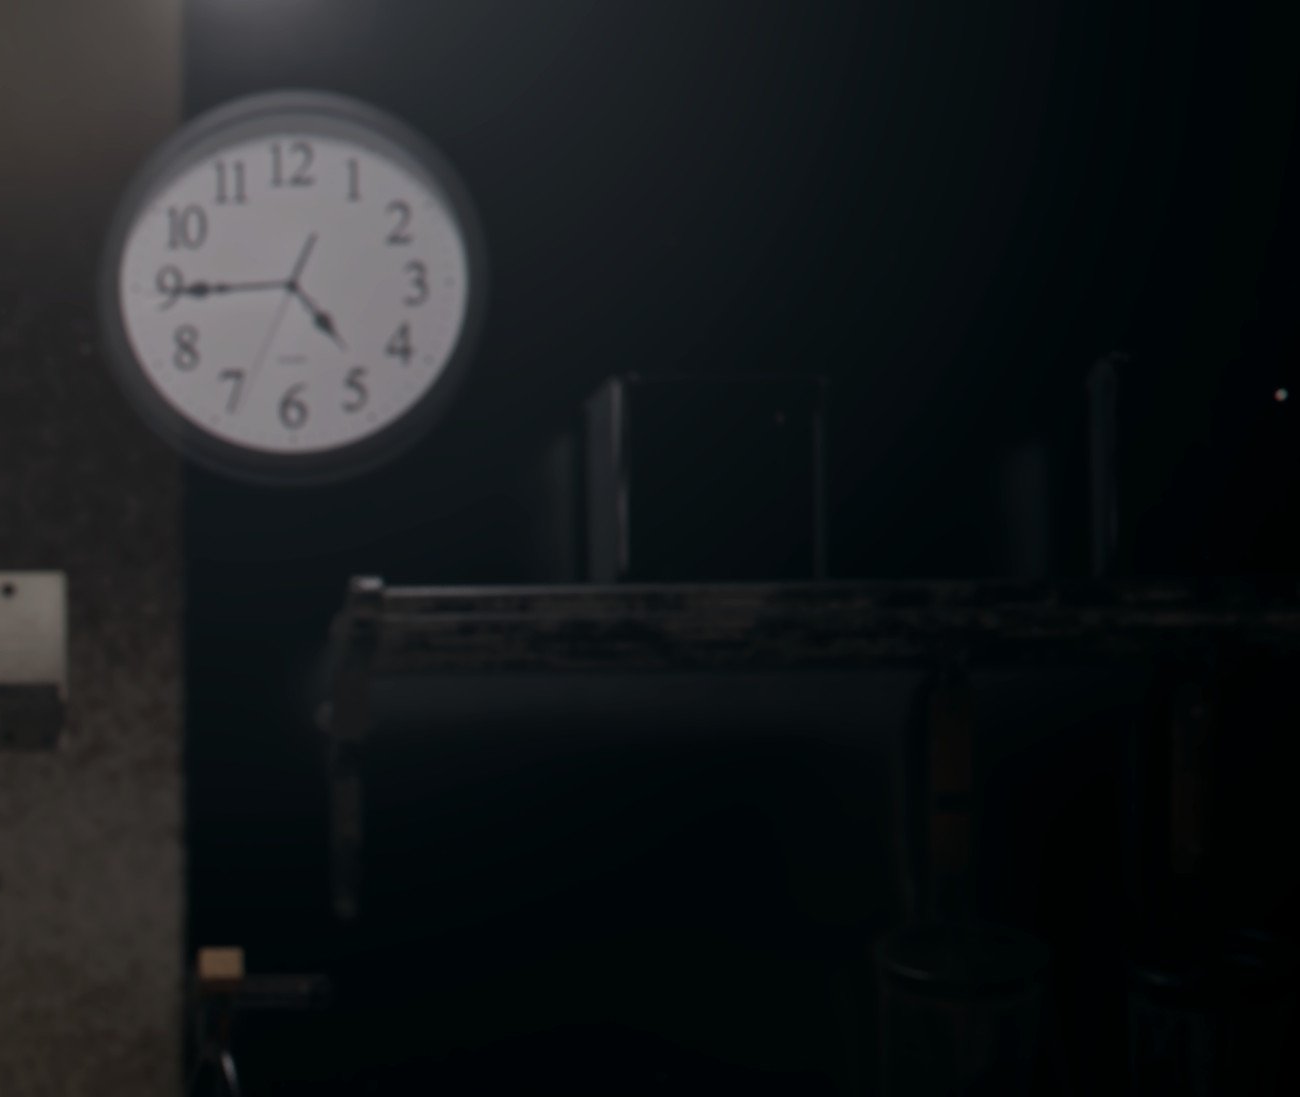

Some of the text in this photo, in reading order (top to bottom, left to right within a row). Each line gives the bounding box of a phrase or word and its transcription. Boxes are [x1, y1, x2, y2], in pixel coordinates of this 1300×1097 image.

[213, 159, 250, 205] 11
[268, 141, 317, 188] 12
[344, 158, 363, 203] 1
[166, 206, 208, 251] 10
[384, 200, 414, 247] 2
[155, 266, 184, 312] 9
[402, 261, 431, 308] 3
[173, 325, 200, 372] 8
[384, 322, 415, 367] 4
[217, 369, 247, 415] 7
[278, 384, 309, 430] 6
[340, 367, 369, 413] 5
